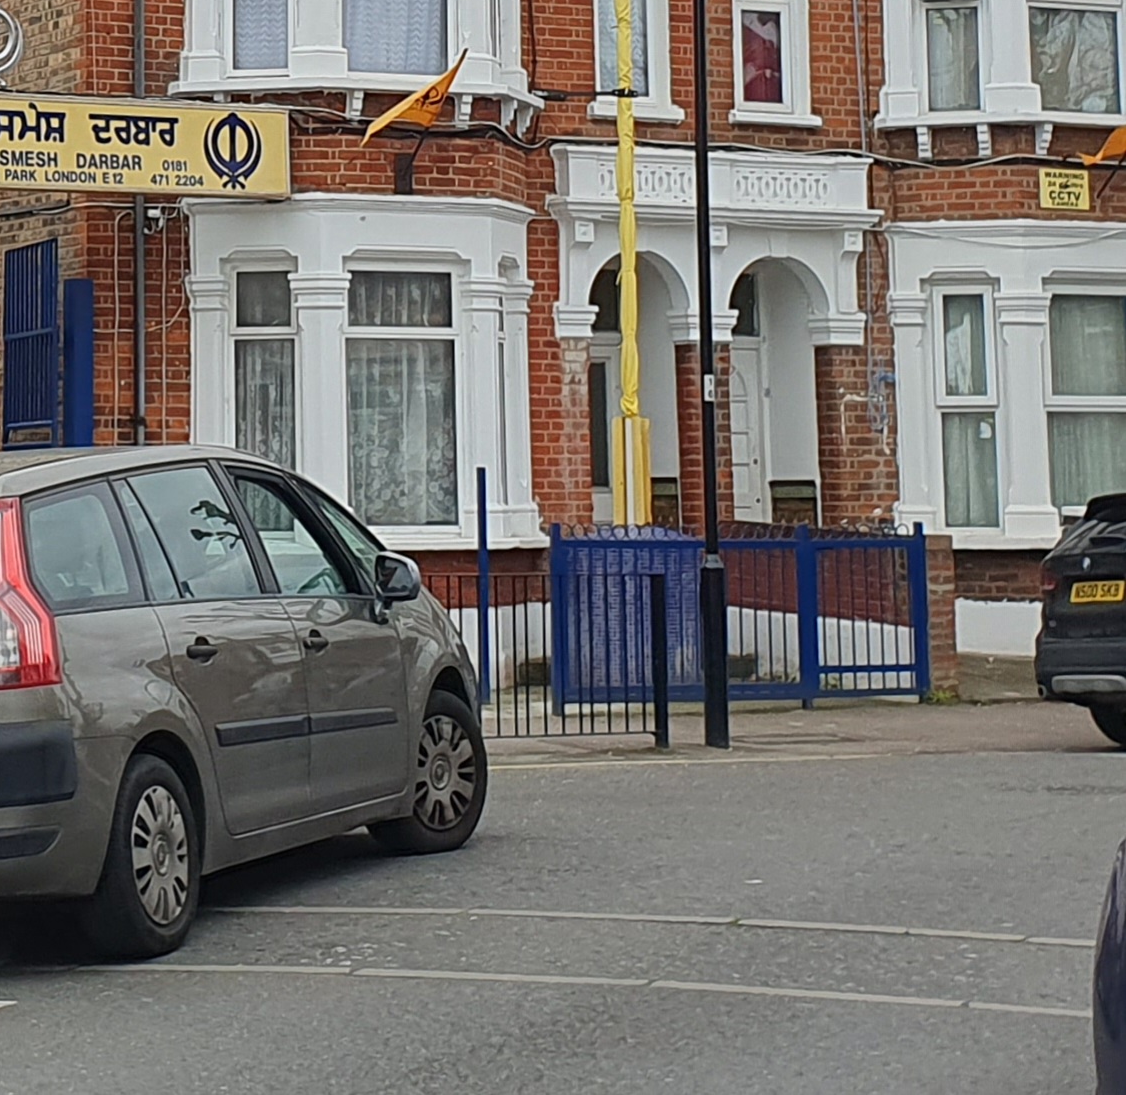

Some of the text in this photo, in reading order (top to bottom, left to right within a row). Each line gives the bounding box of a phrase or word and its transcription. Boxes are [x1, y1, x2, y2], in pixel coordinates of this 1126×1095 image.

[88, 113, 179, 147] ਦਰਬਾਰ
[76, 153, 142, 170] DARBAR
[162, 159, 188, 172] 0181
[4, 168, 37, 183] PARK
[44, 170, 96, 184] LONDON
[150, 174, 204, 187] 471 2204
[1044, 171, 1084, 180] WARNING
[1049, 190, 1081, 201] CCTV
